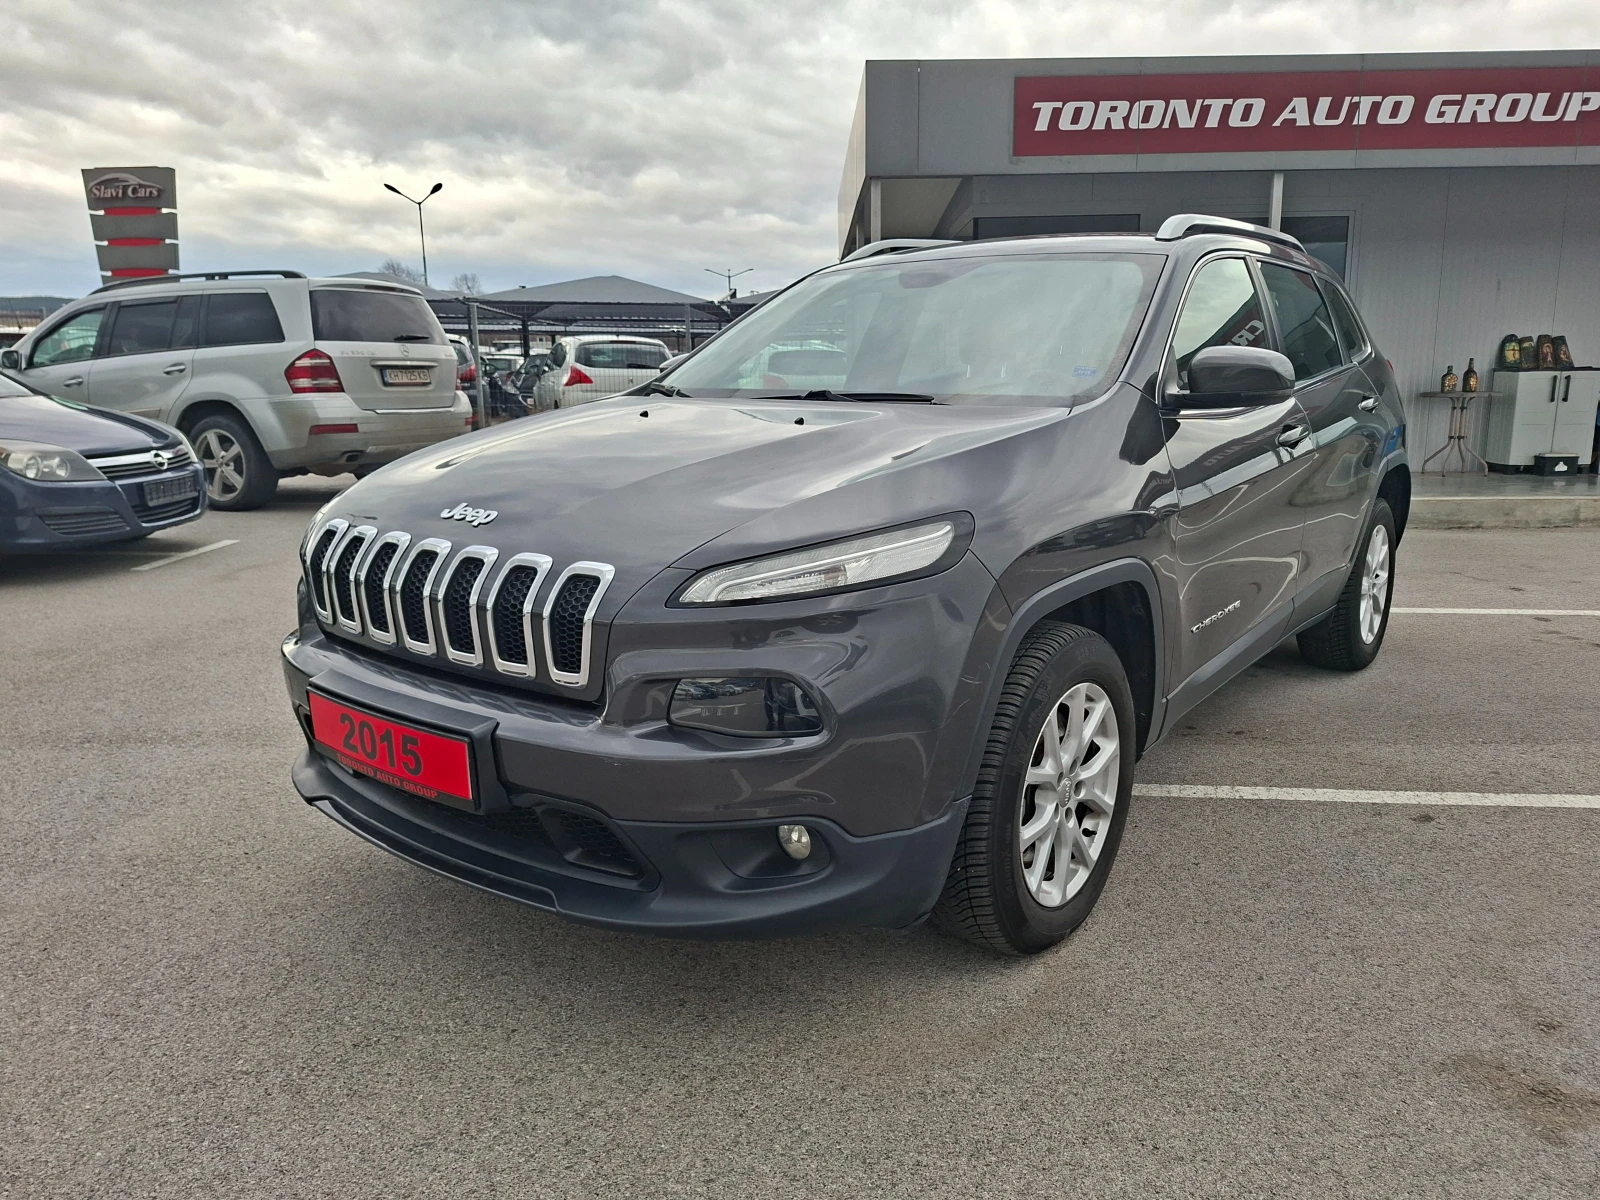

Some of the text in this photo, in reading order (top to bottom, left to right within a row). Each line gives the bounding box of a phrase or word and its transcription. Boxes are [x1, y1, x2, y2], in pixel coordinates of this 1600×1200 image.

[1032, 91, 1600, 132] TORONTO AUTO GROUP
[91, 185, 159, 198] Slavi Cars
[440, 502, 498, 528] Jeep
[1190, 600, 1241, 633] CHEROKEE
[339, 712, 424, 777] 2015
[336, 753, 438, 799] TORONTO AUTO GROUP
